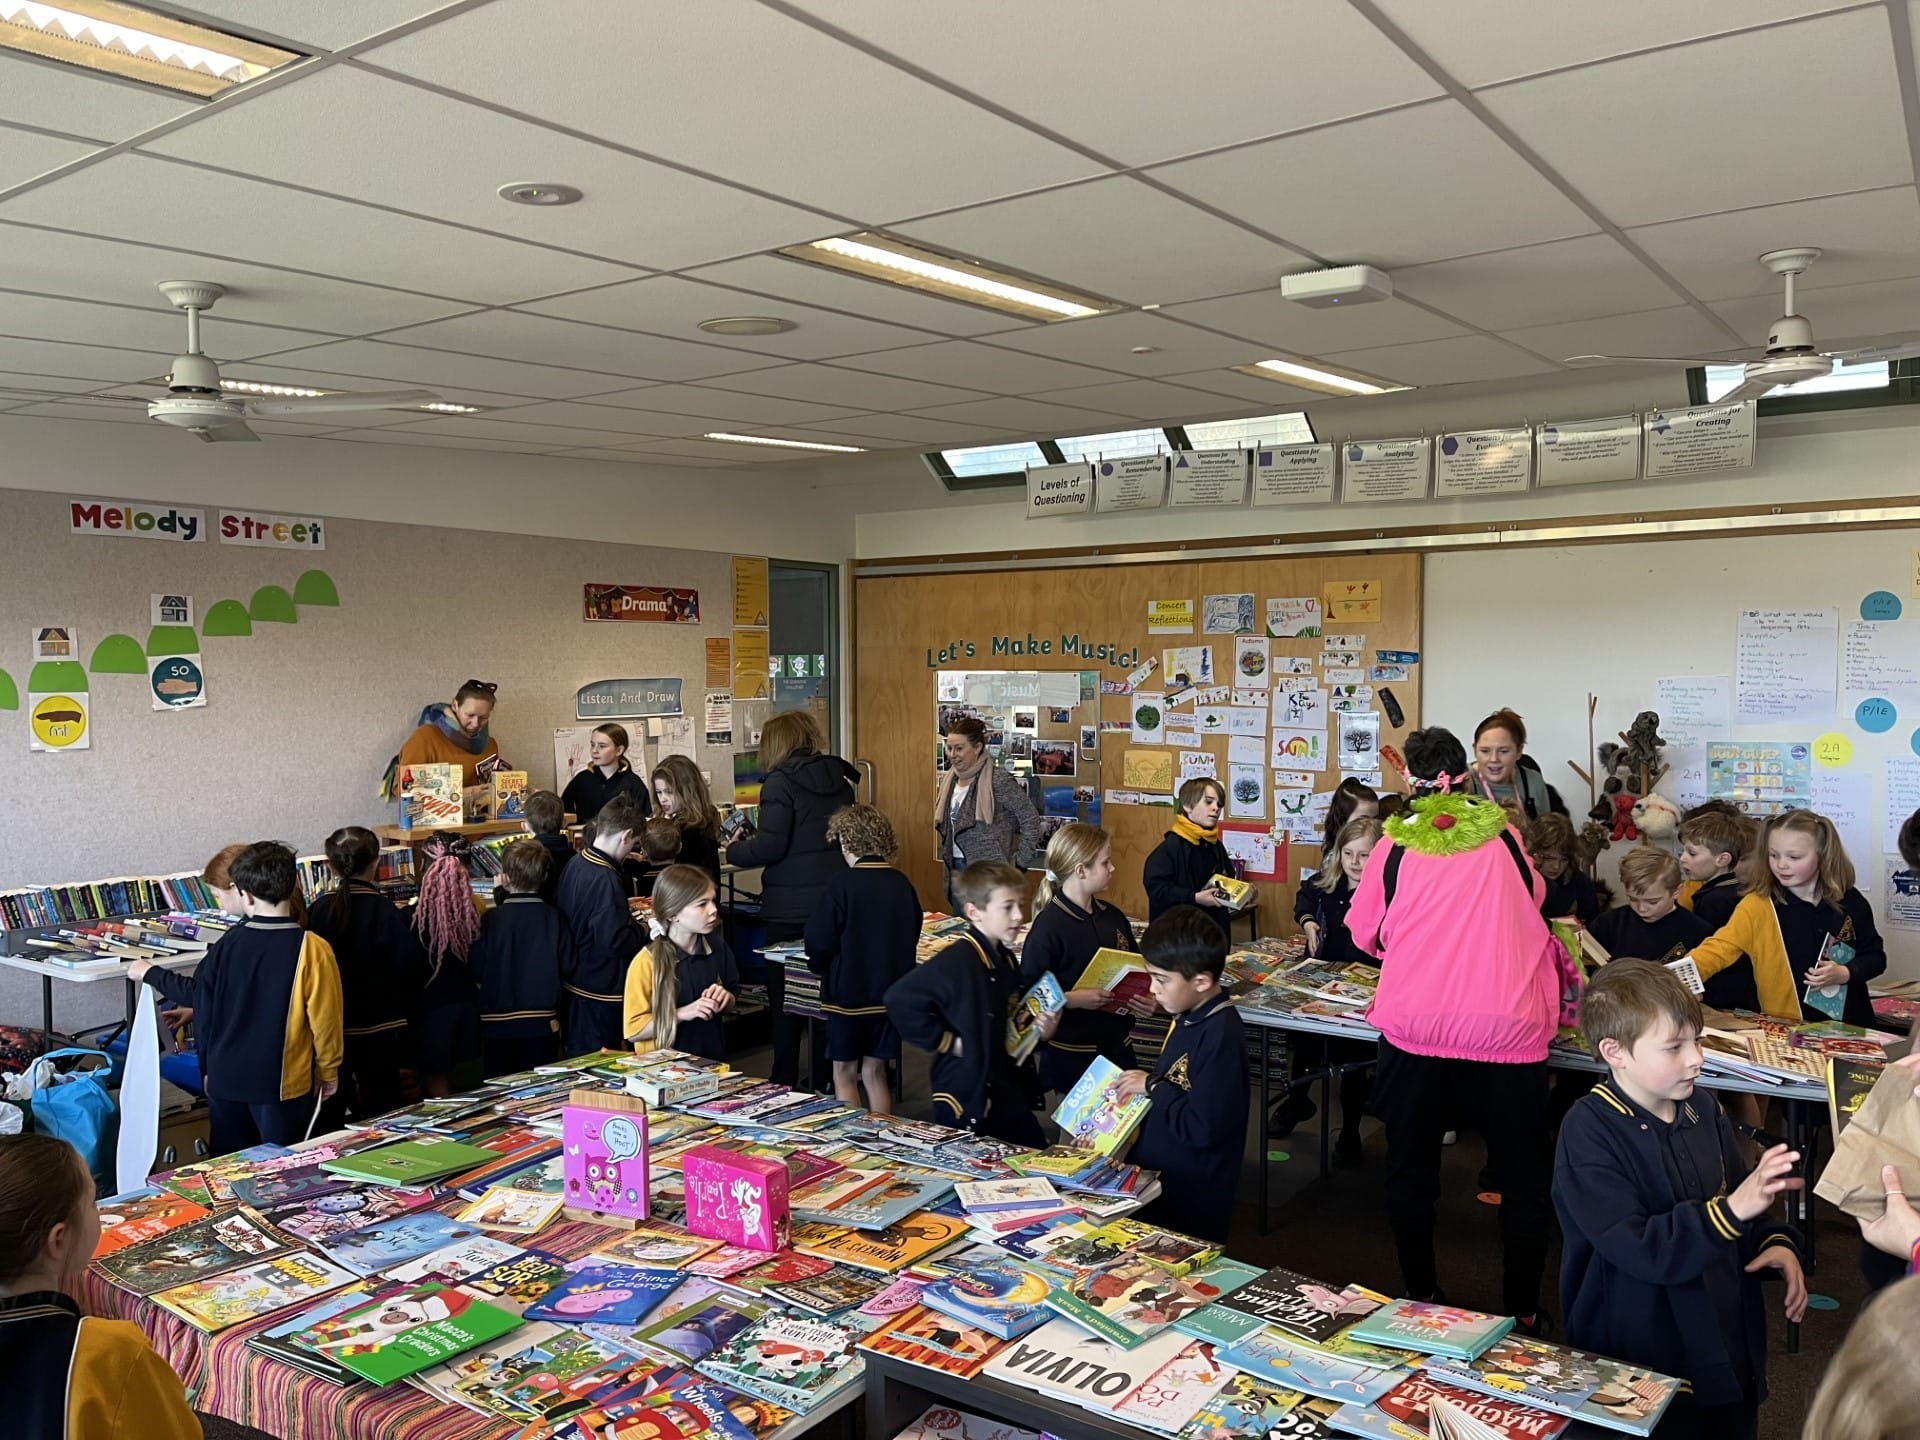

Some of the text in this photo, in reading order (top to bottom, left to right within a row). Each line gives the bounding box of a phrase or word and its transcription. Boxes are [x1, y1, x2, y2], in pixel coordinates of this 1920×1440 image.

[1696, 417, 1731, 428] Creating
[1280, 450, 1310, 458] Questions
[1289, 457, 1317, 465] Applying
[1041, 477, 1080, 491] Levels of
[1034, 491, 1085, 507] Questioning
[71, 503, 321, 544] Melody Street
[621, 596, 667, 613] Drama
[1155, 601, 1186, 611] Concert
[1148, 613, 1194, 625] Reflections
[927, 633, 1139, 669] Let's Make Music!
[581, 690, 675, 705] Listen And Draw
[421, 795, 461, 818] SWAP
[1067, 1072, 1096, 1109] BLUEY
[689, 1176, 728, 1219] Pearlie
[808, 1207, 883, 1224] WOMBAT
[483, 1265, 533, 1286] SOR
[512, 1259, 558, 1276] BEDT
[631, 1272, 676, 1283] Prince
[607, 1280, 671, 1290] George
[1249, 1284, 1306, 1306] Unicorn
[841, 1314, 866, 1326] THE
[1055, 1297, 1132, 1344] Grandad's Mask
[1233, 1289, 1329, 1334] Thelma
[412, 1326, 460, 1351] Christmas
[432, 1320, 475, 1342] Macca's
[1385, 1320, 1449, 1338] Kind
[398, 1335, 441, 1357] Crackers
[876, 1335, 967, 1371] OLIVIA
[1255, 1341, 1337, 1371] ISLAND
[1005, 1343, 1132, 1397] OLIVIA
[680, 1386, 724, 1424] Wheels
[1400, 1381, 1556, 1438] MACDONAL
